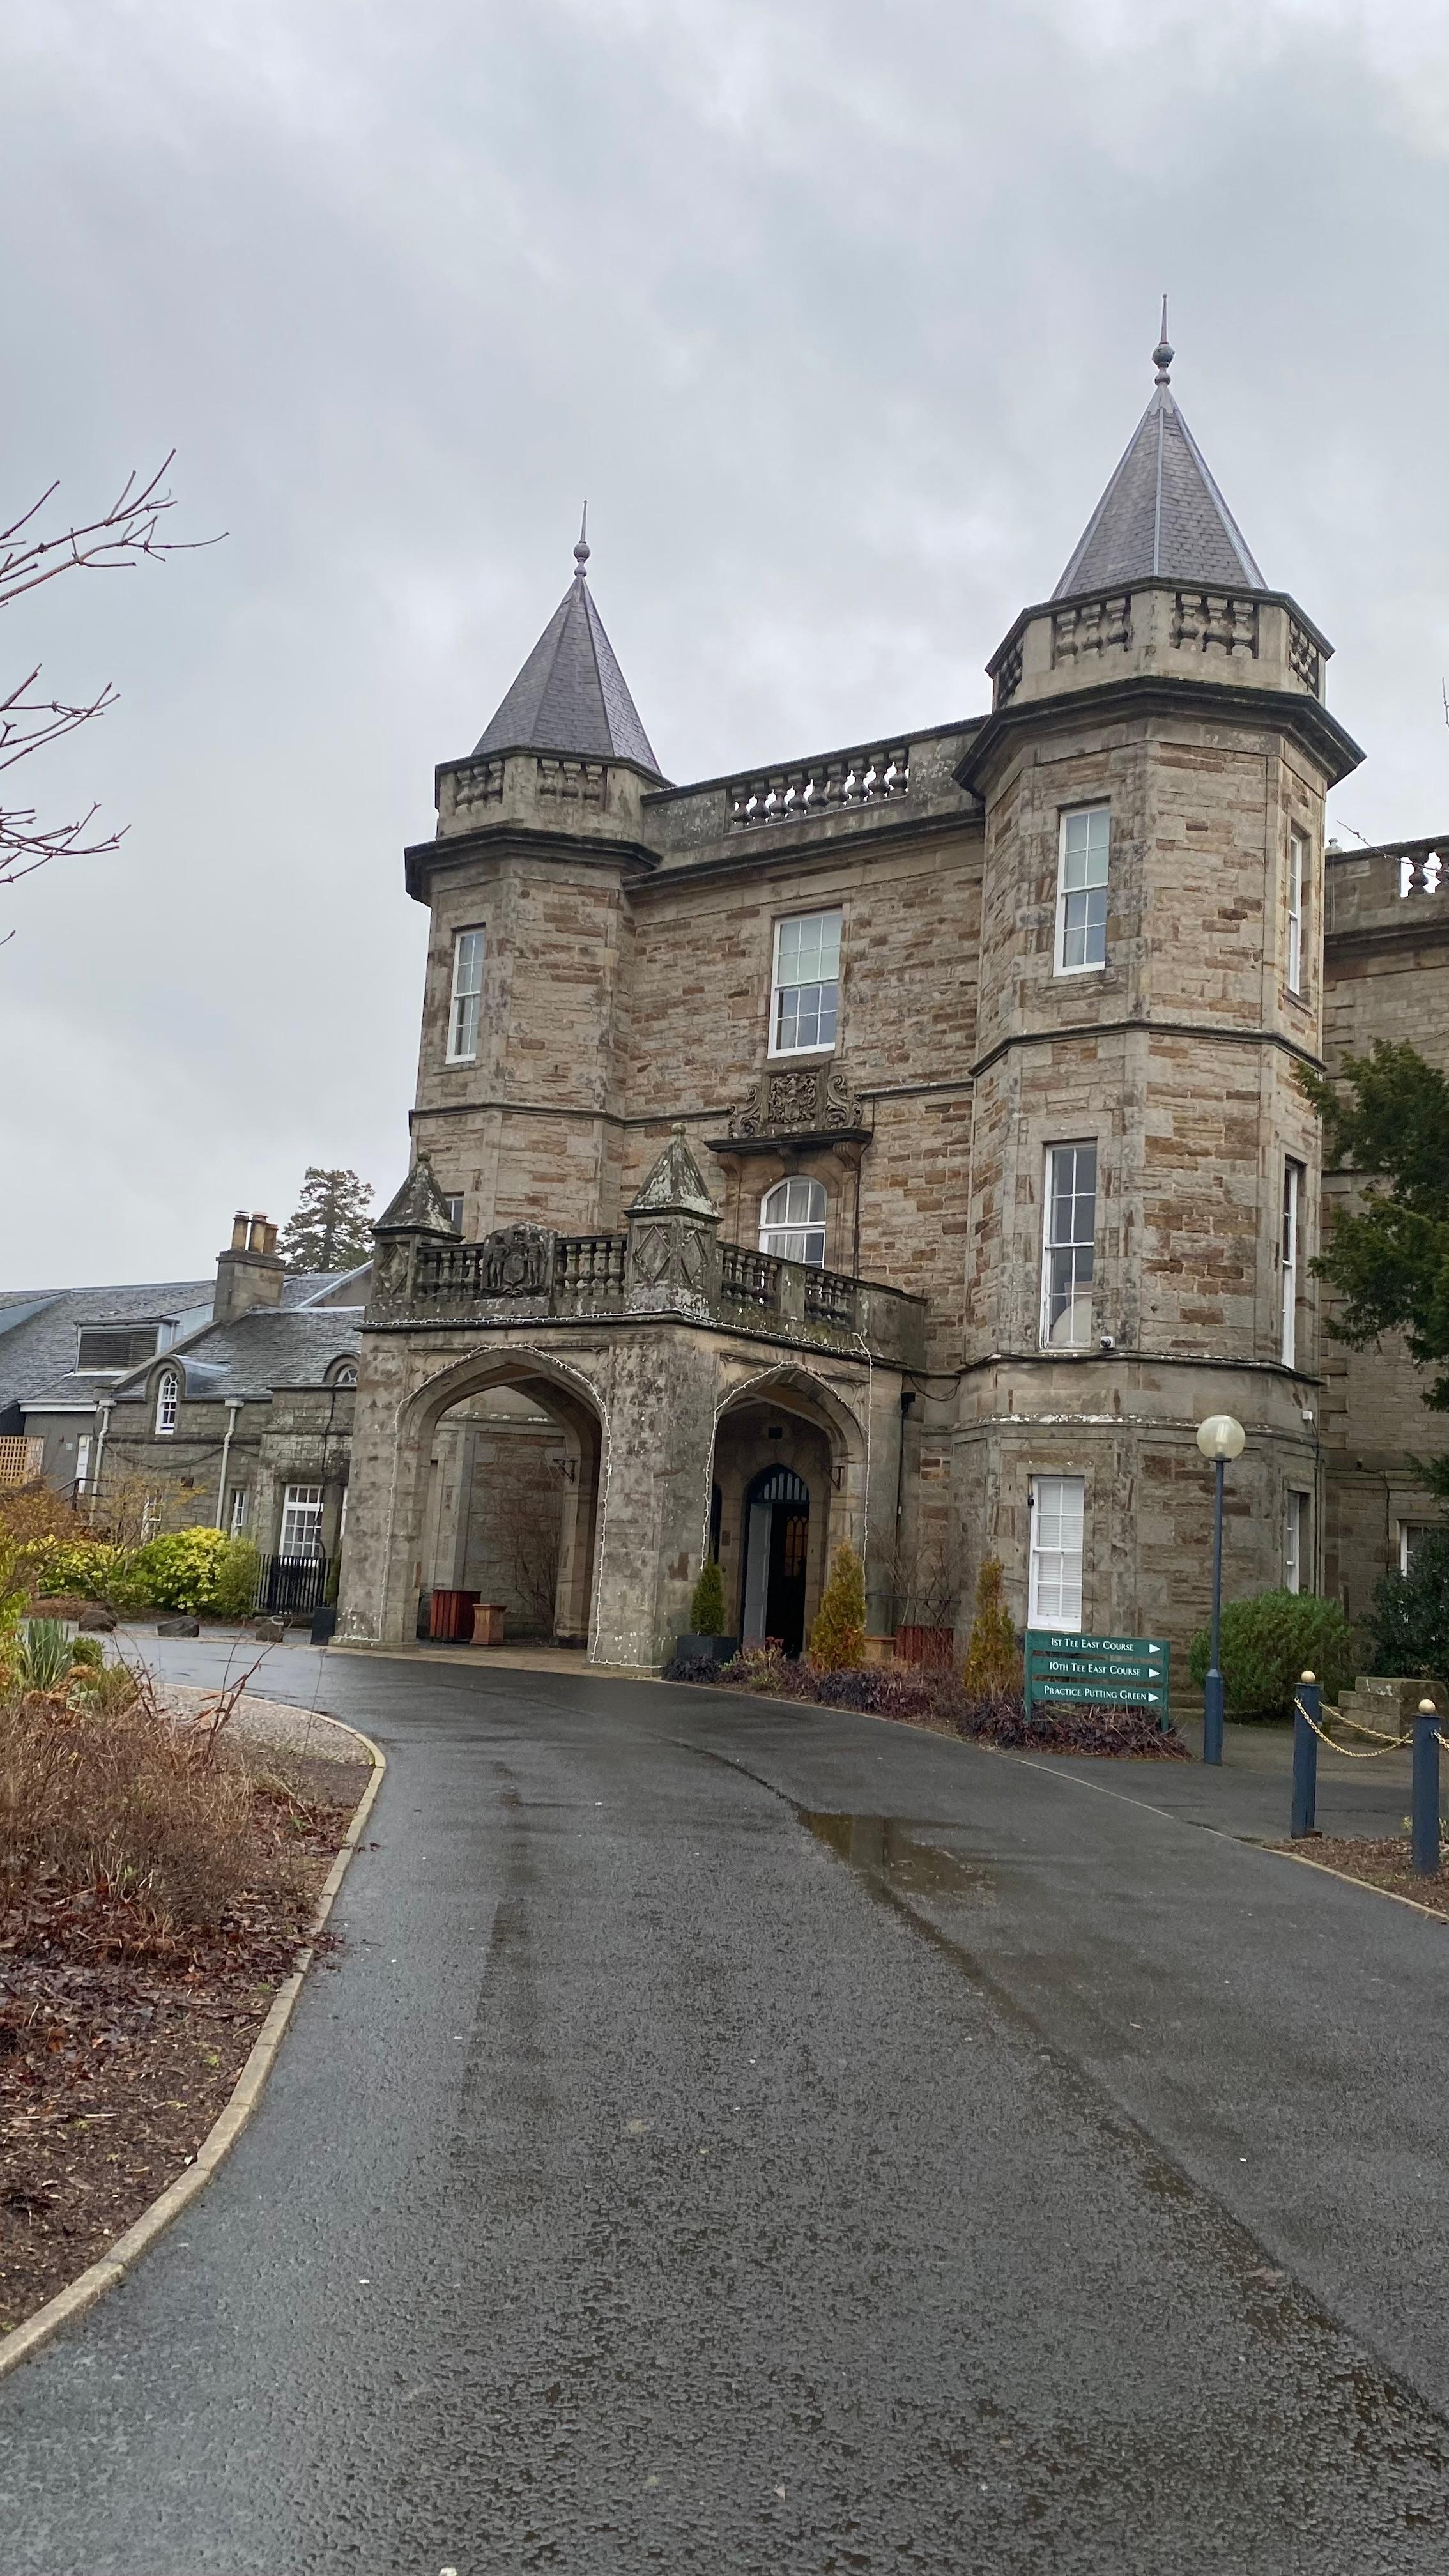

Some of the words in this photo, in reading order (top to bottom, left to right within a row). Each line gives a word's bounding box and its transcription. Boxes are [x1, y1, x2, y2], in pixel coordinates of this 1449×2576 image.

[1064, 1638, 1078, 1648] TEE
[1081, 1639, 1100, 1648] EAST
[1103, 1641, 1134, 1652] COURSE
[1049, 1662, 1068, 1671] 10TH
[1071, 1662, 1085, 1672] TEE
[1088, 1664, 1107, 1673] EAST
[1109, 1666, 1140, 1676] COURSE
[1044, 1685, 1081, 1697] PRACTICE
[1084, 1688, 1117, 1699] PUTTING
[1119, 1690, 1147, 1700] GREEN
